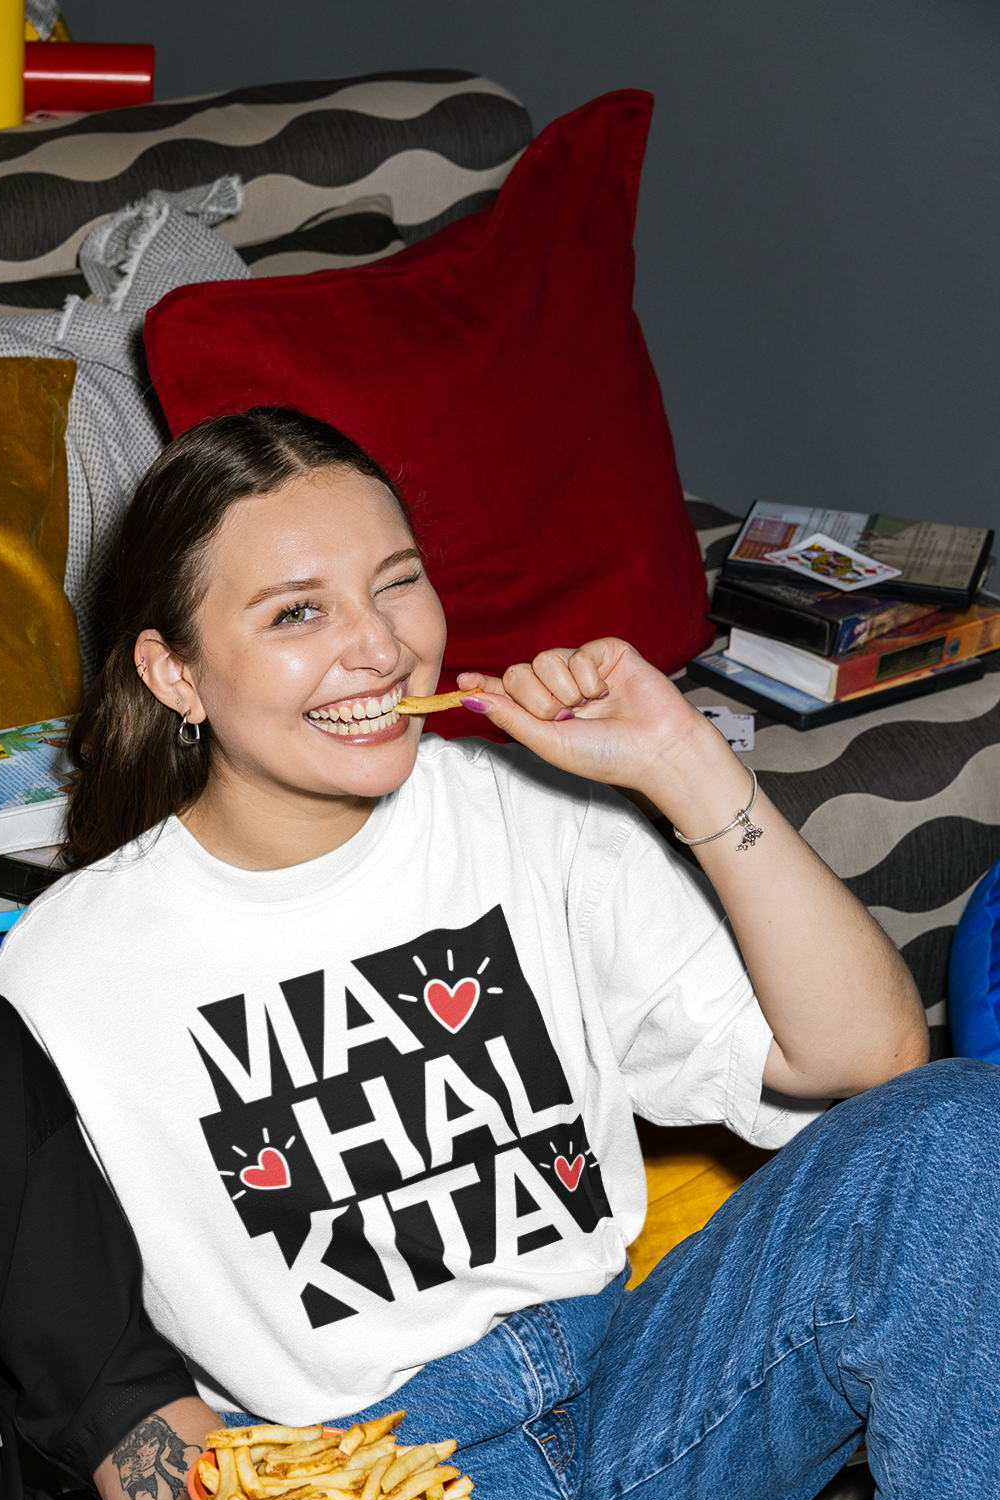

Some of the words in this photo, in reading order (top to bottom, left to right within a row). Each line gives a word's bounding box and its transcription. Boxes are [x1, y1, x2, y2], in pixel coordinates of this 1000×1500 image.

[168, 961, 426, 1119] MA
[290, 1034, 580, 1203] HAL
[250, 1145, 613, 1332] KITA
